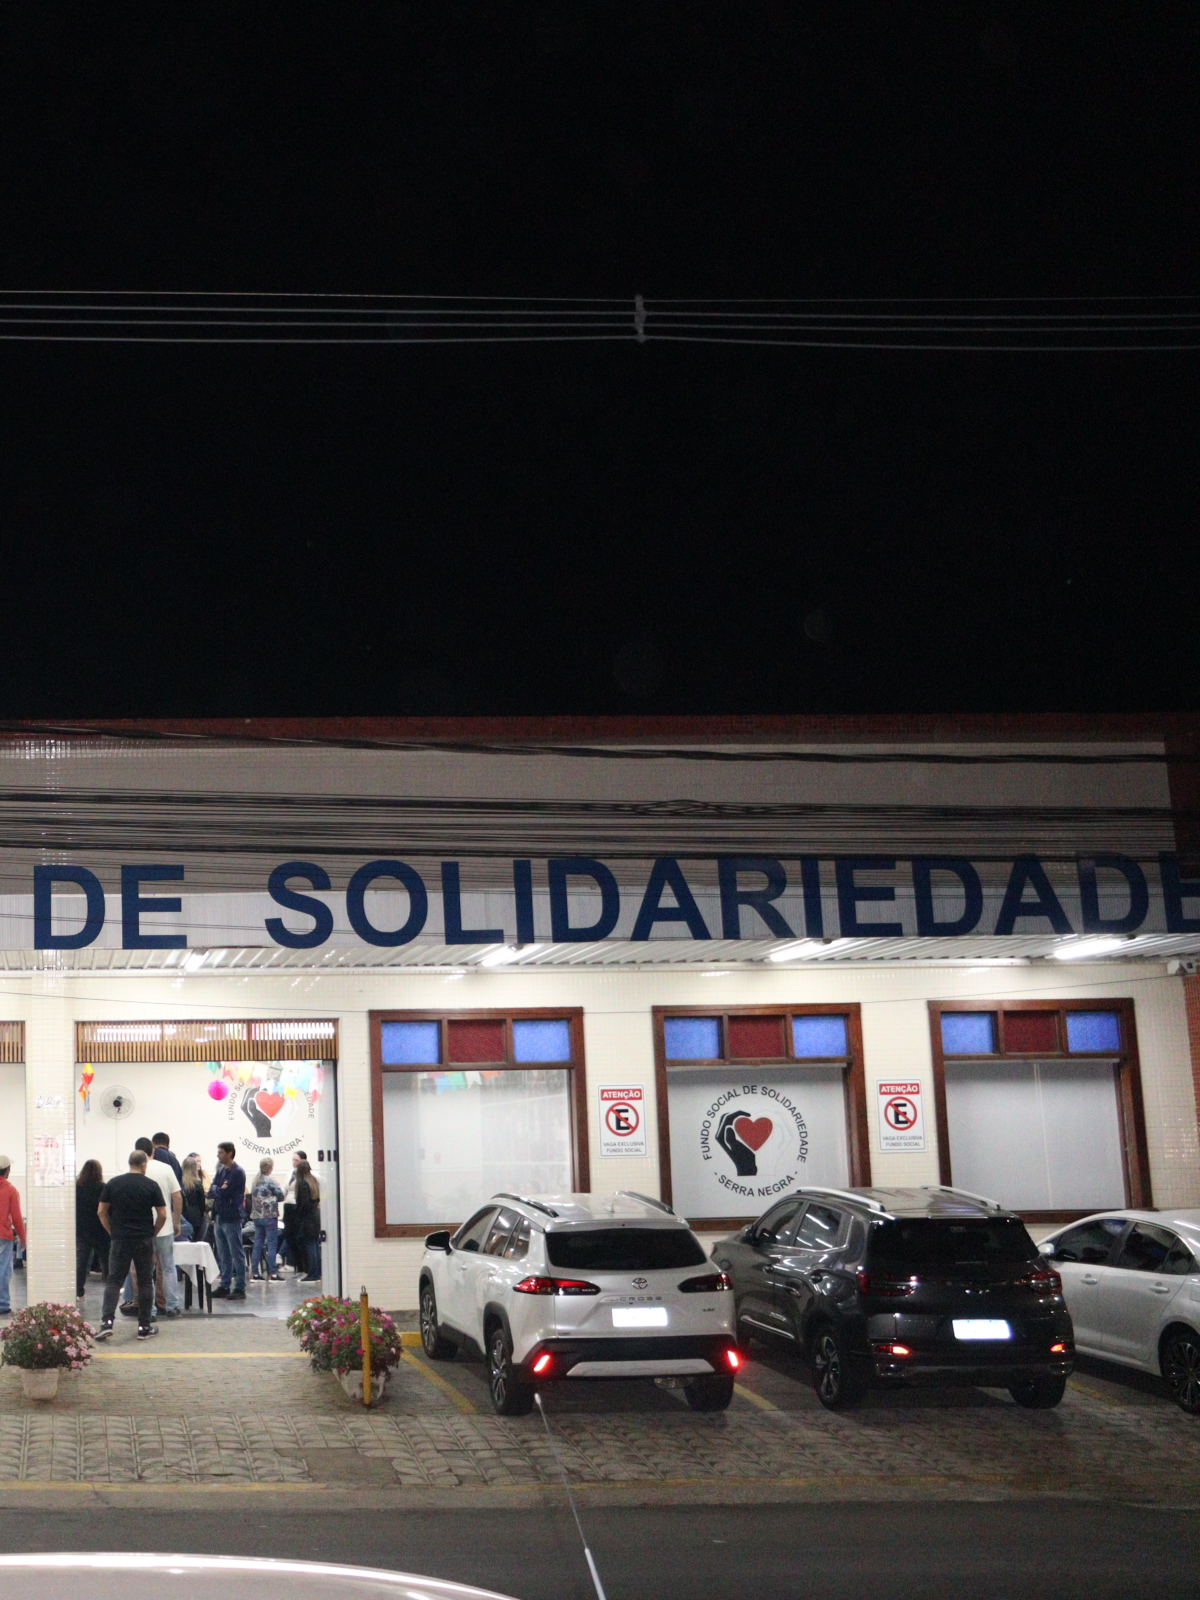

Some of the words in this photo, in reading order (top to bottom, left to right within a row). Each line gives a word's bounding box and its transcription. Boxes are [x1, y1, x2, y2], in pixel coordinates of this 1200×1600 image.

[34, 864, 188, 950] DE
[264, 853, 1200, 949] SOLIDARIEDADE
[602, 1089, 641, 1100] ATENÇÃO
[880, 1084, 918, 1094] ATENÇÃO
[228, 1092, 237, 1121] FUNDO
[700, 1120, 712, 1161] FUNDO
[707, 1088, 741, 1119] SOCIAL
[742, 1085, 758, 1095] DE
[761, 1086, 809, 1164] SOLIDARIEDADE
[242, 1138, 271, 1156] SERRA
[272, 1137, 303, 1156] NEGRA
[718, 1174, 755, 1197] SERRA
[757, 1174, 795, 1197] NEGRA
